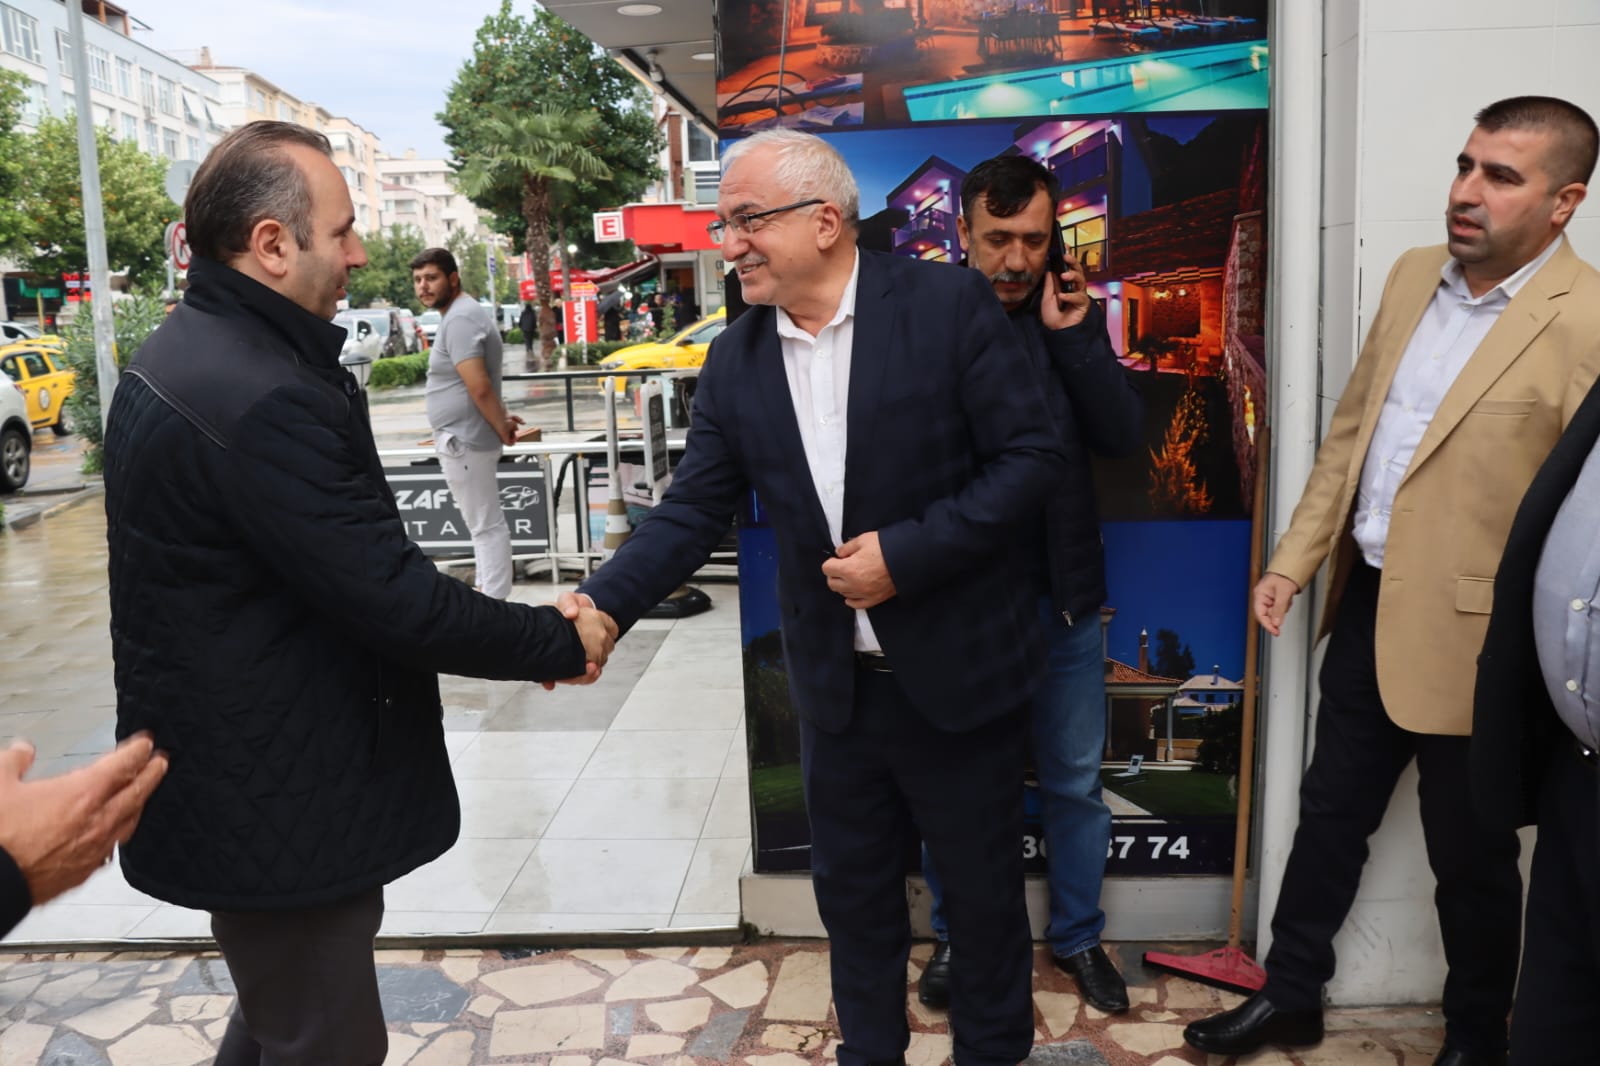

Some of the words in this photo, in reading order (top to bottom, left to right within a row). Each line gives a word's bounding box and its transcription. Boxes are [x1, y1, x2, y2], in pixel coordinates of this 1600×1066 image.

[602, 219, 616, 236] E
[395, 489, 460, 510] ZAF
[440, 520, 458, 535] A
[1147, 836, 1190, 859] 74
